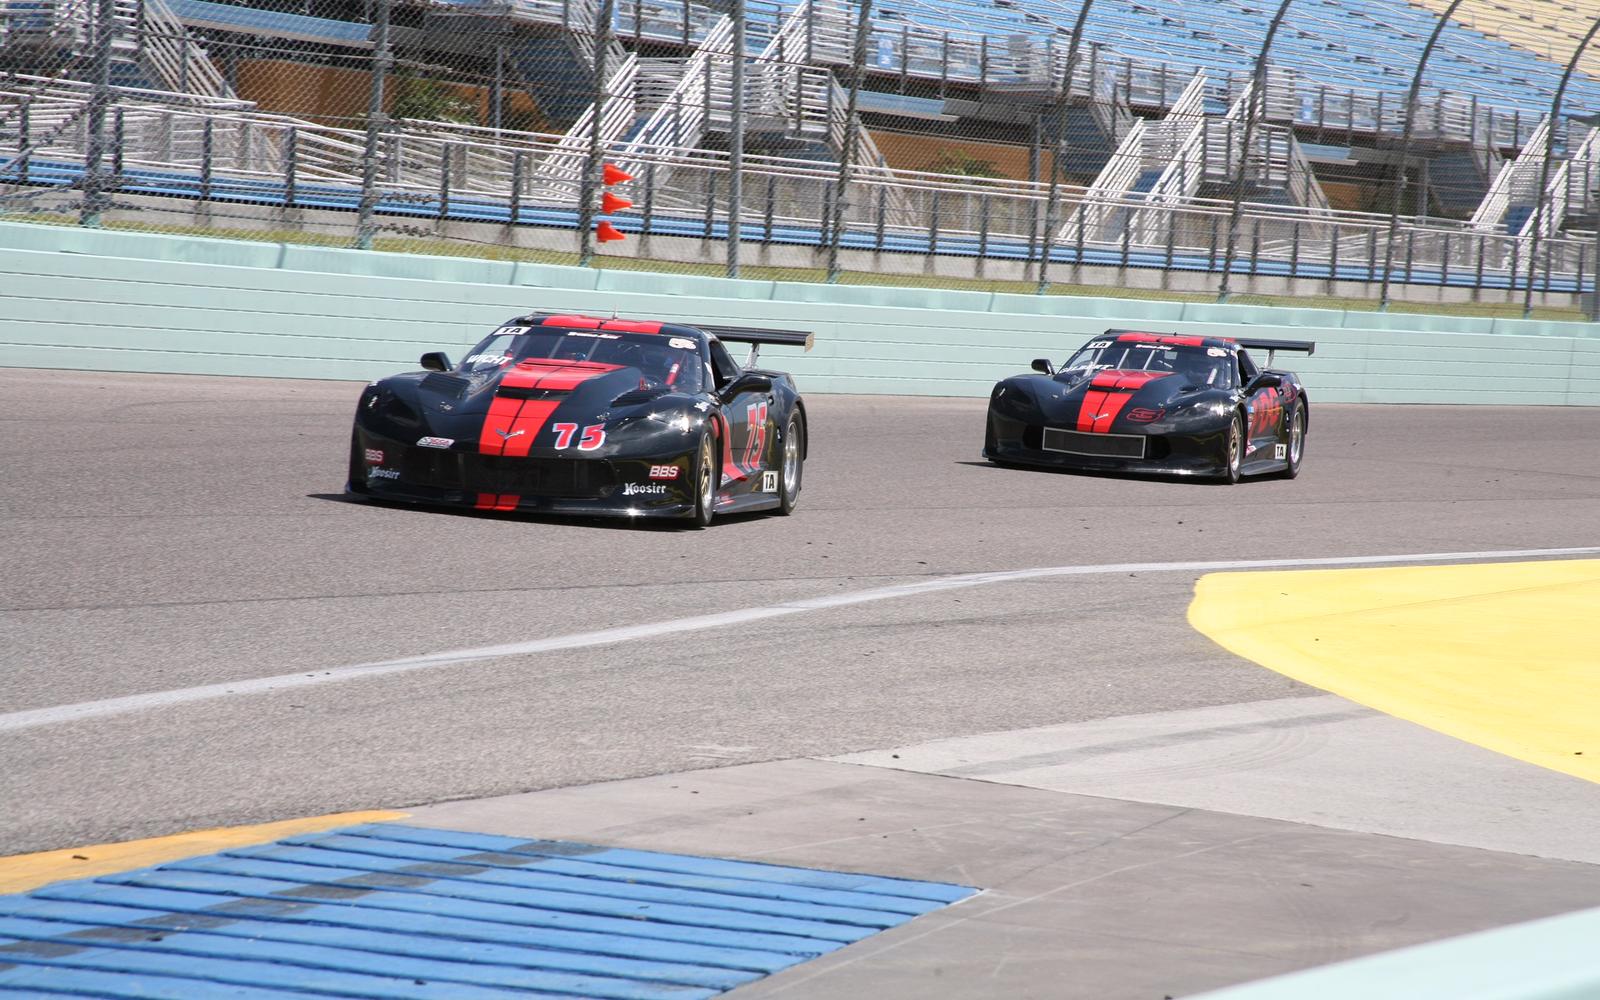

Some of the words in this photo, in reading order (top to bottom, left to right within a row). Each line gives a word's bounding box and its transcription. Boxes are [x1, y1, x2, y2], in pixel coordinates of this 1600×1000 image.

[552, 422, 606, 451] 75
[741, 401, 768, 472] 75
[649, 465, 679, 478] BBS
[622, 482, 667, 496] Hoosier
[764, 474, 775, 489] TA
